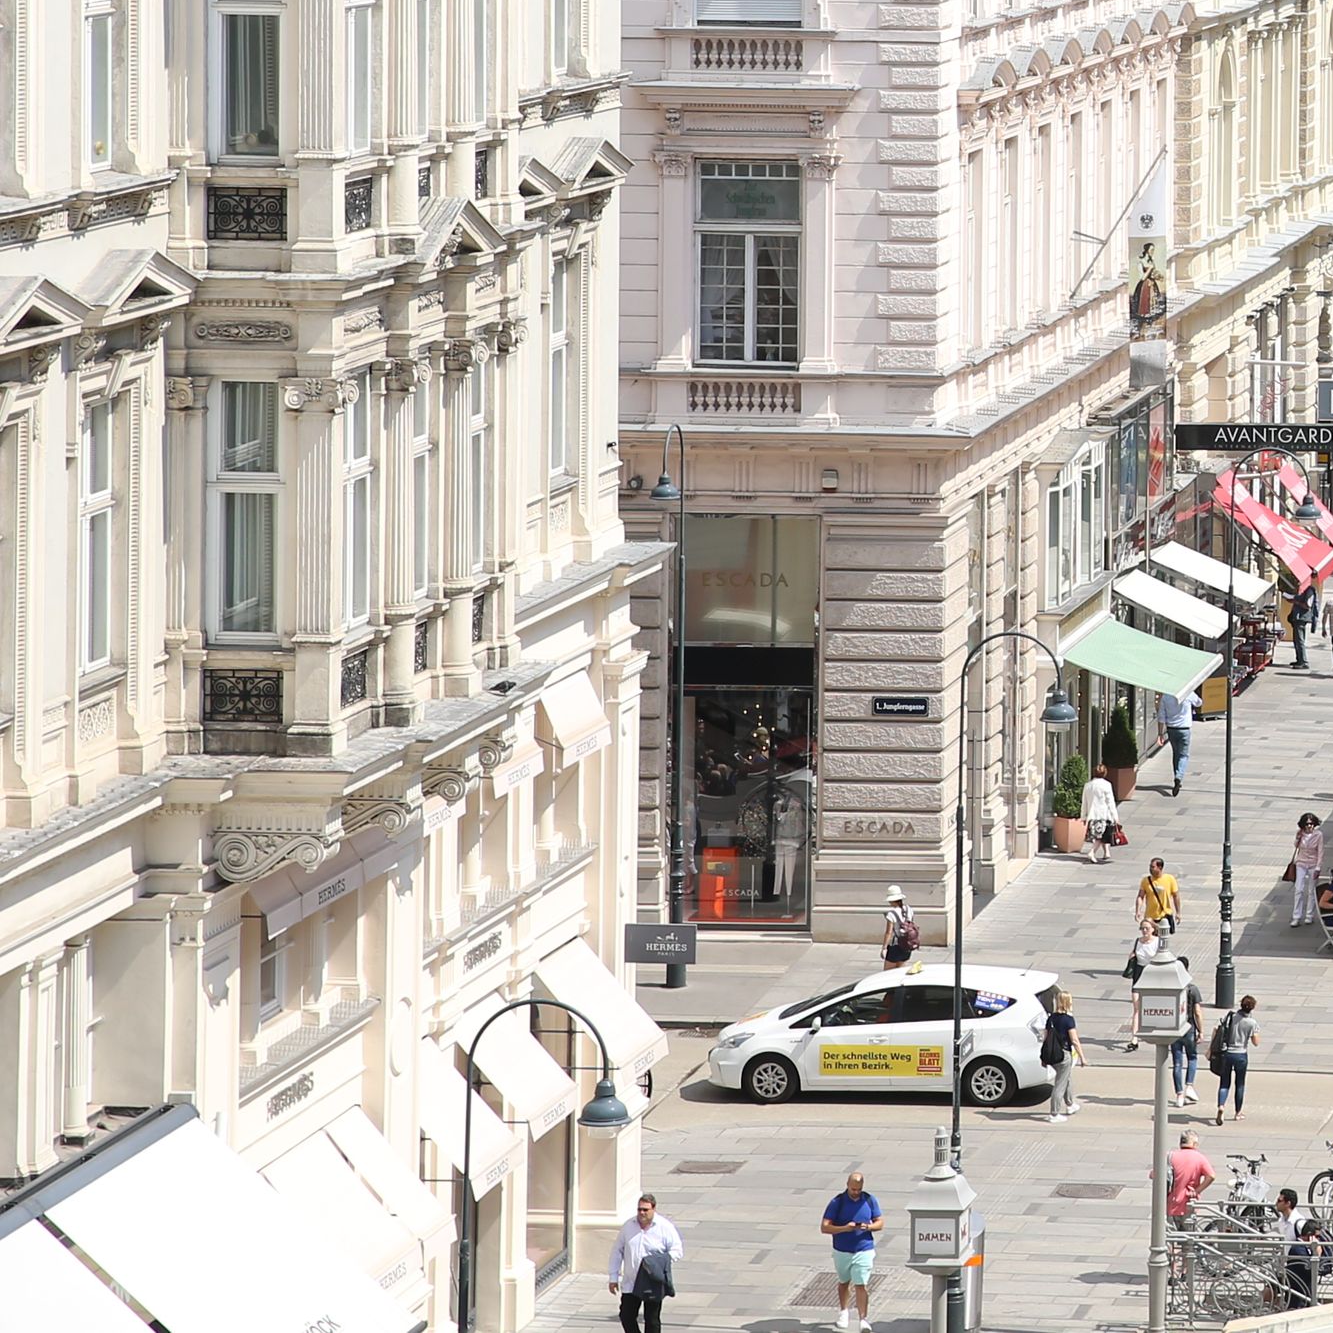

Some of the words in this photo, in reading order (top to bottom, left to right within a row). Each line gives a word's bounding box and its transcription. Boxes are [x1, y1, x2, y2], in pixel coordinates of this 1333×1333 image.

[702, 572, 790, 588] ESCADA
[844, 820, 916, 834] ESCADA
[1143, 1008, 1174, 1016] HERREN
[823, 1052, 841, 1061] Der
[842, 1052, 888, 1061] schnellste
[890, 1053, 912, 1063] Weg
[919, 1058, 940, 1066] BLATT
[823, 1061, 833, 1069] in
[834, 1061, 859, 1070] Ihren
[861, 1061, 893, 1070] Bezirk.
[918, 1232, 952, 1242] DAMEN
